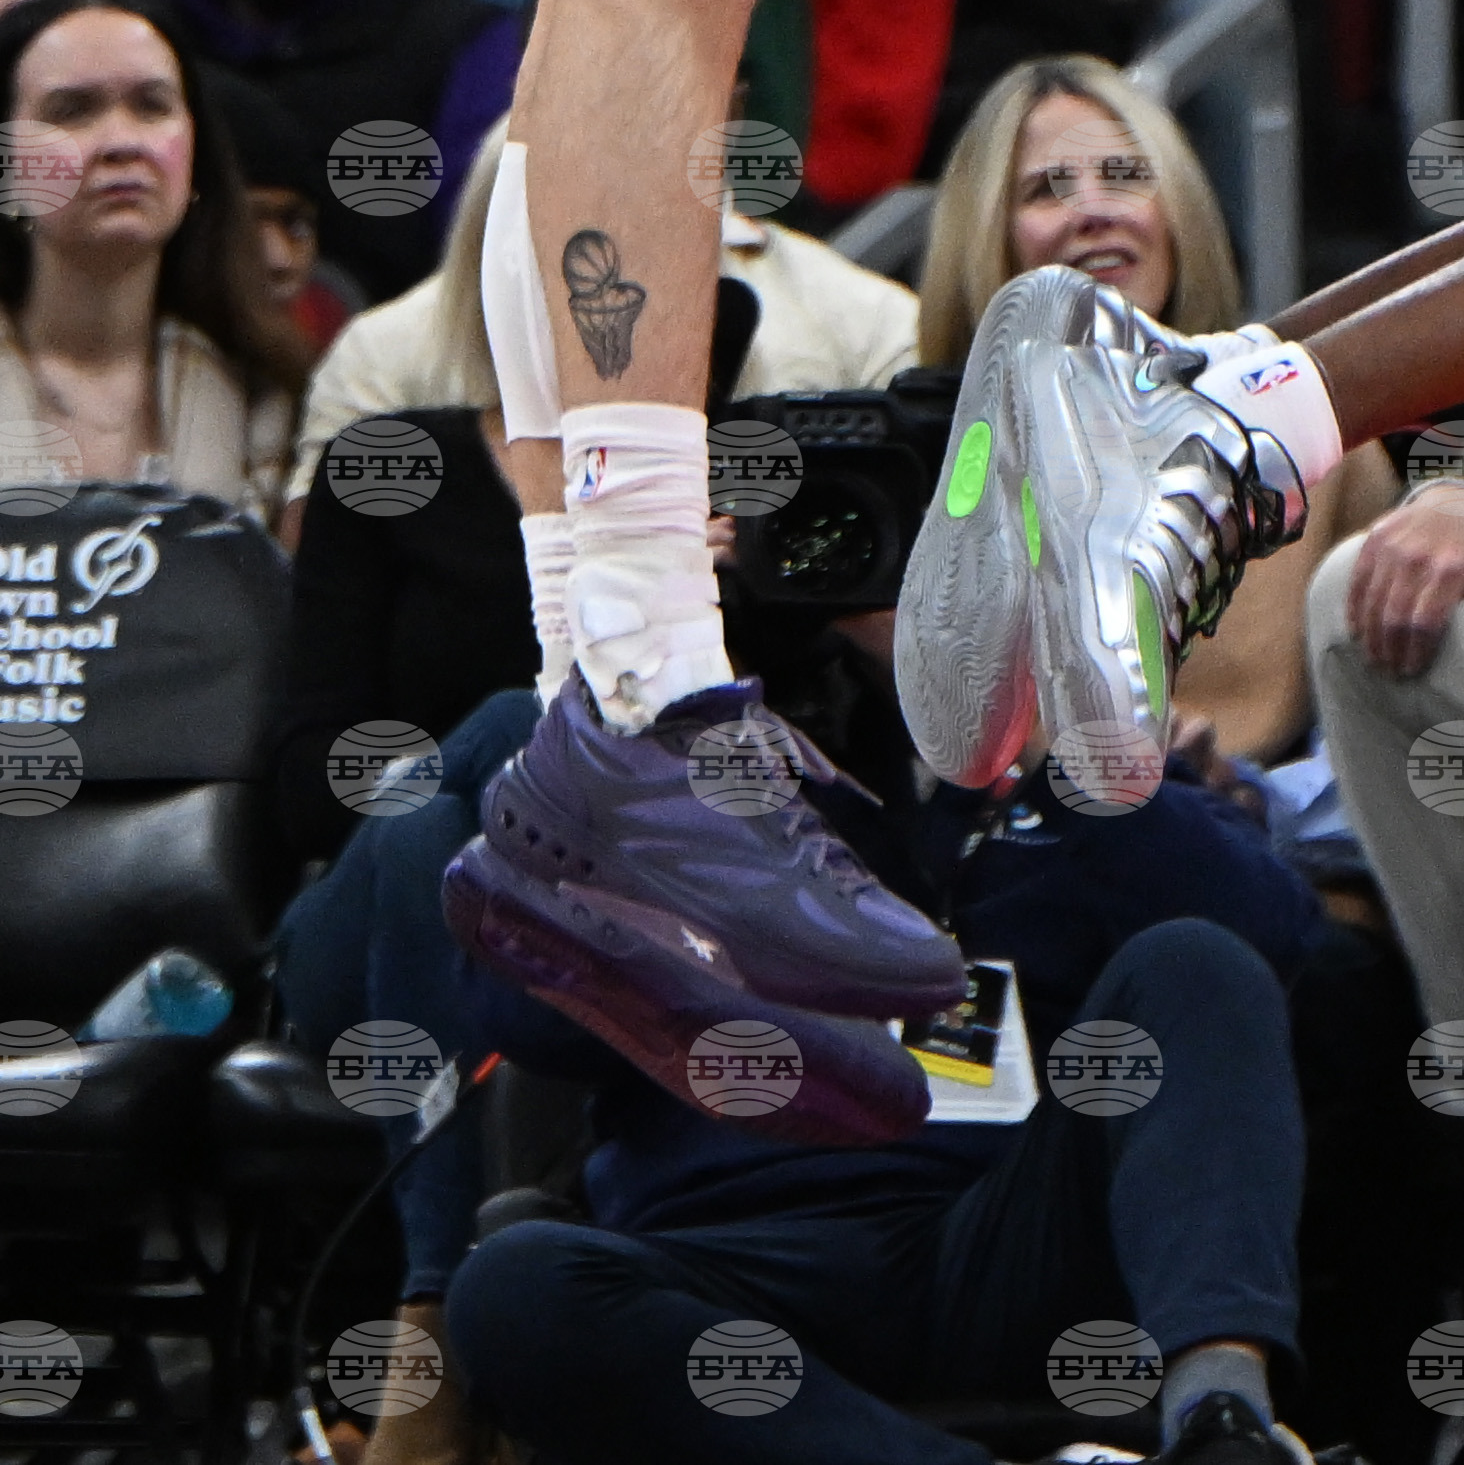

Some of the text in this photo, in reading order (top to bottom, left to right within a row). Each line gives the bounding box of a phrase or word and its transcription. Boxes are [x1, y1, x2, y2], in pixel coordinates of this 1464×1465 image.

[0, 543, 58, 582] ld
[0, 614, 119, 650] hool
[0, 652, 86, 685] olk
[0, 685, 86, 723] sic
